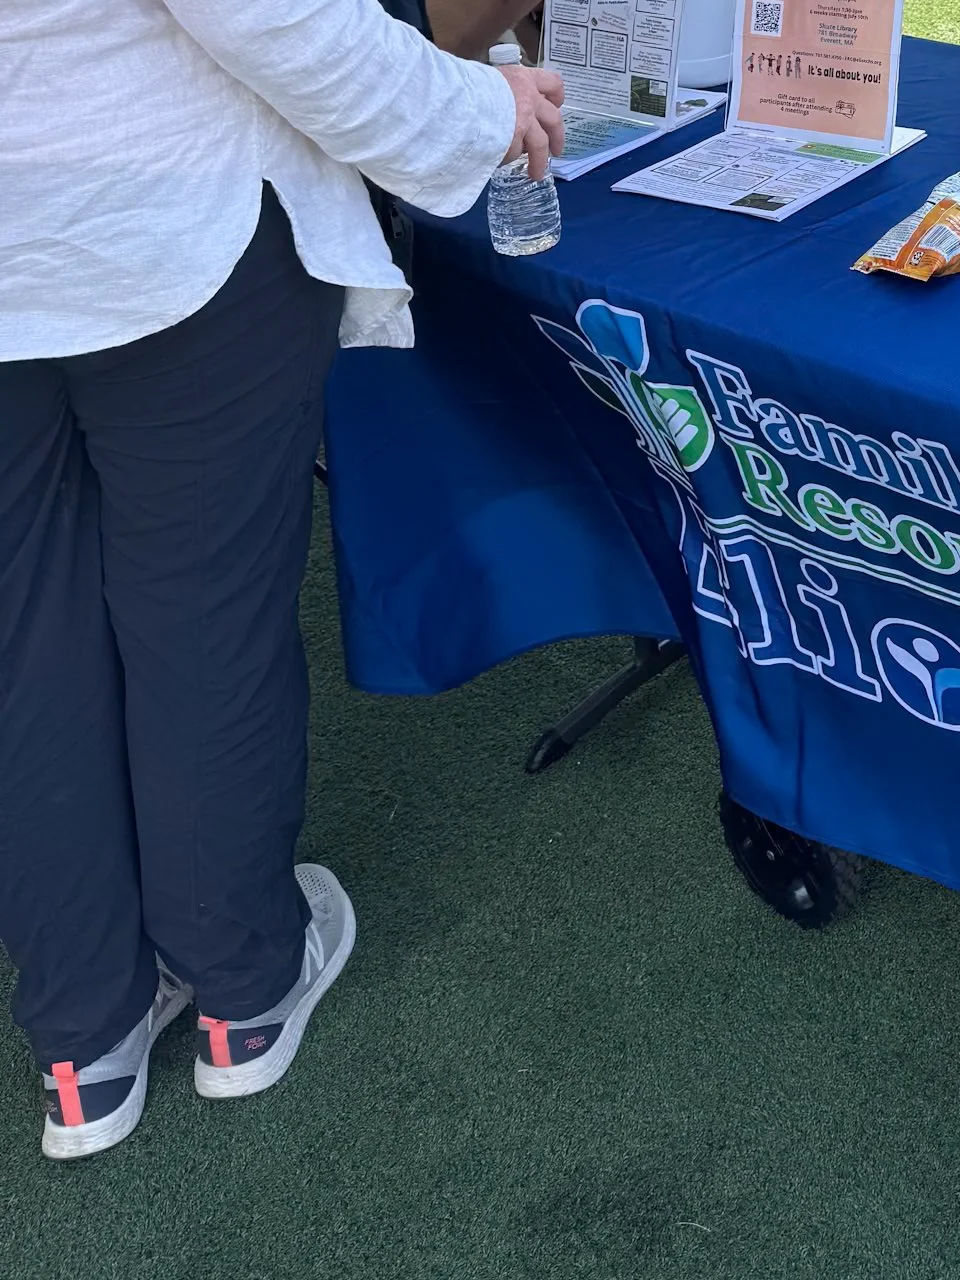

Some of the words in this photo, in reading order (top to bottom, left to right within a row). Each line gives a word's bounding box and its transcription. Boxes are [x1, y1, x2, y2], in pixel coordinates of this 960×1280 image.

[829, 11, 847, 19] starting
[837, 25, 858, 33] Library
[829, 30, 858, 40] Broadway
[820, 37, 842, 45] Everett,
[808, 65, 822, 76] It's
[823, 67, 834, 78] all
[835, 69, 861, 81] about
[863, 73, 881, 84] you!
[760, 98, 792, 107] participants
[792, 101, 806, 109] after
[806, 103, 833, 113] attending
[785, 107, 809, 116] meetings
